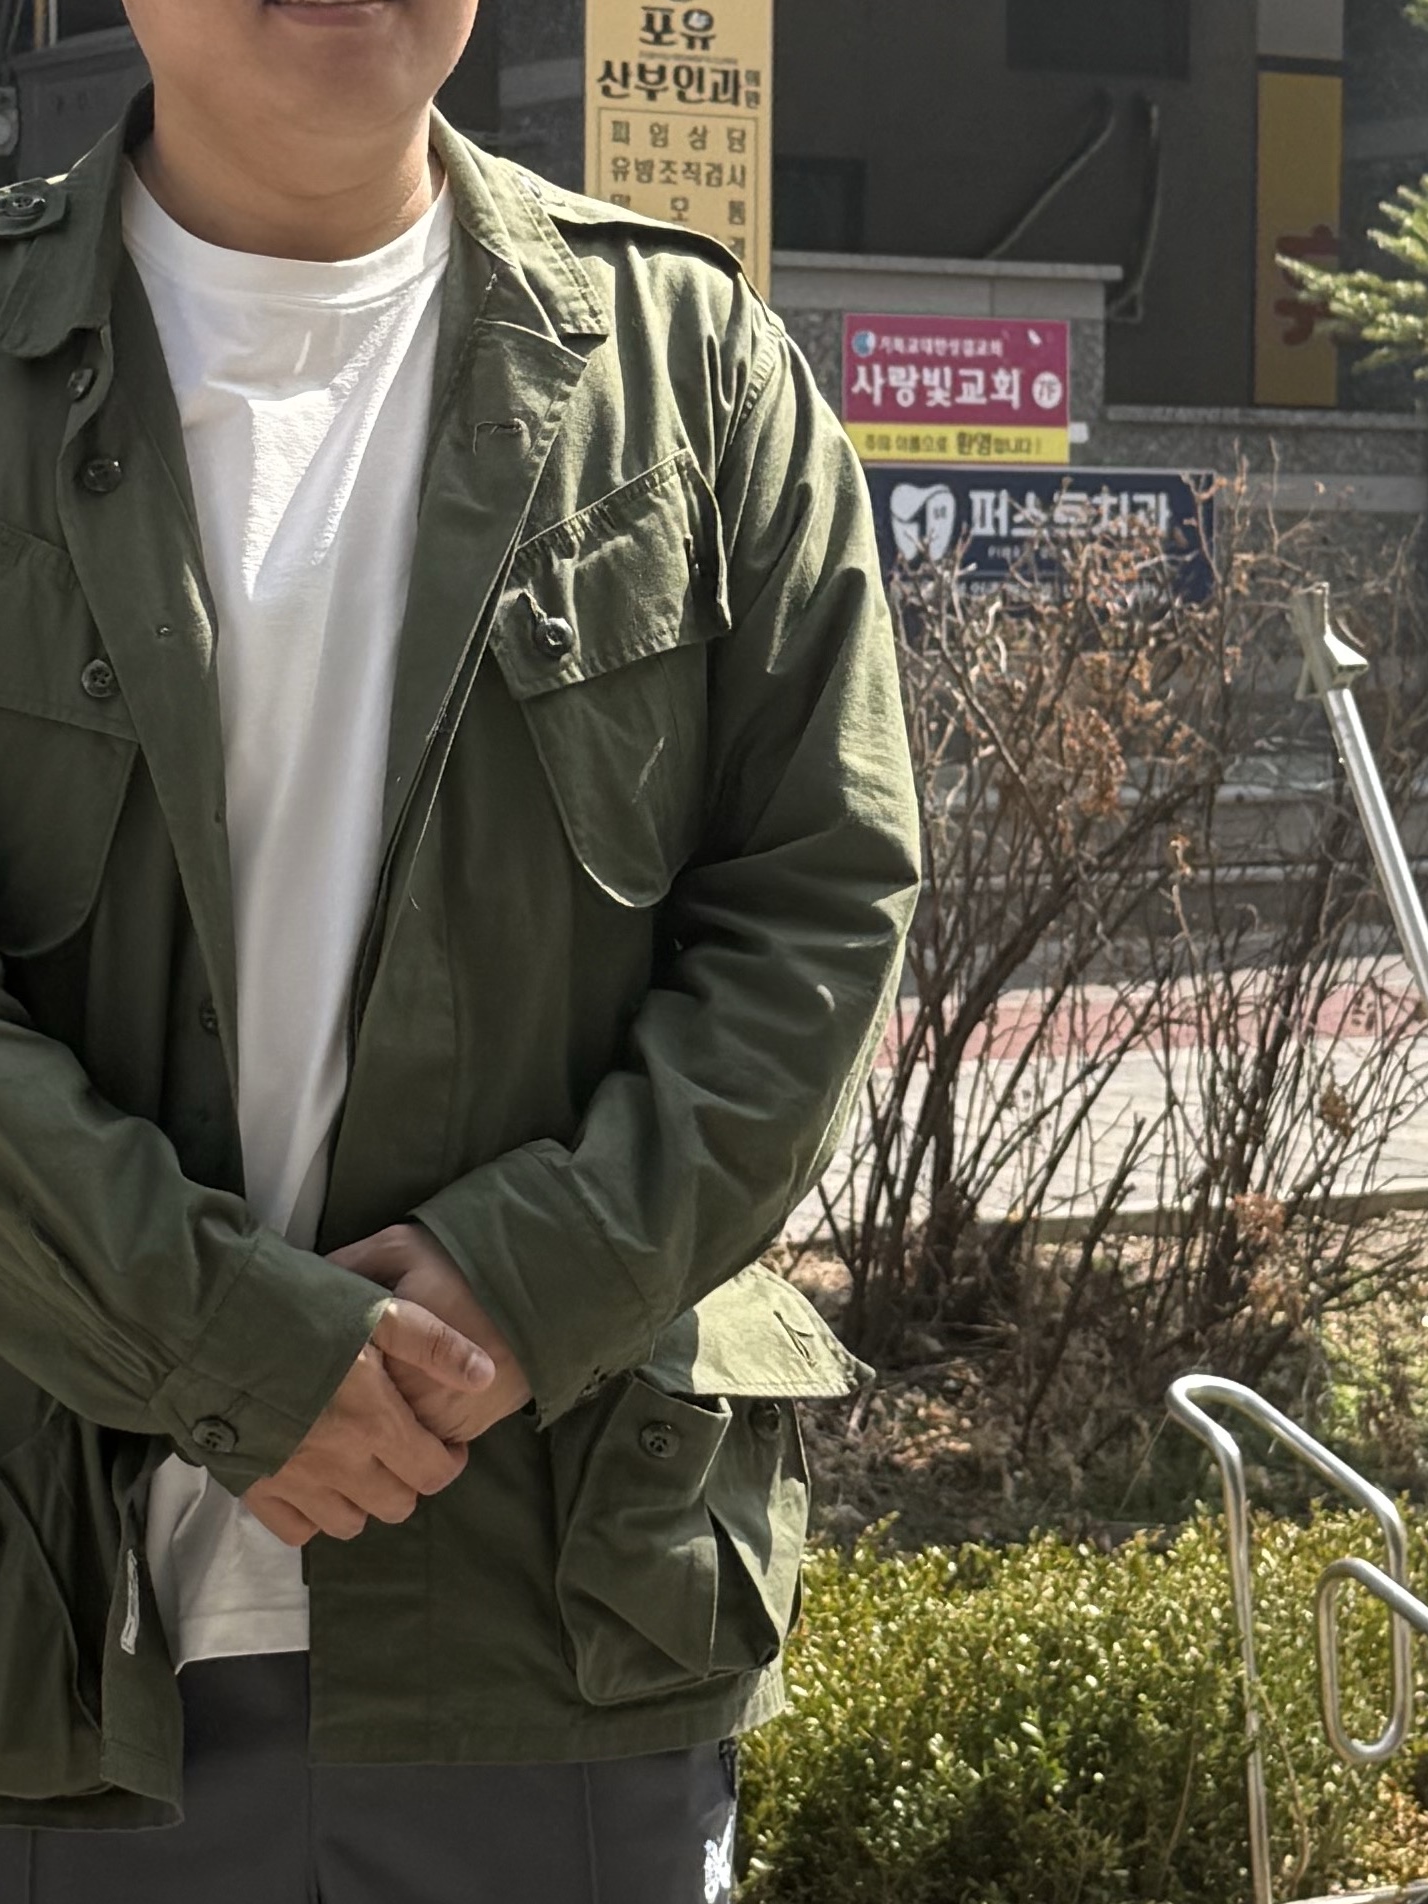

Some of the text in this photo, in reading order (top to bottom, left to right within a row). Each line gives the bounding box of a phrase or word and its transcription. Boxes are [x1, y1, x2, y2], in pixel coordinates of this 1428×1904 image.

[639, 5, 717, 51] 포유
[597, 59, 741, 107] 산부인과
[851, 363, 1021, 411] 사랑빛교회
